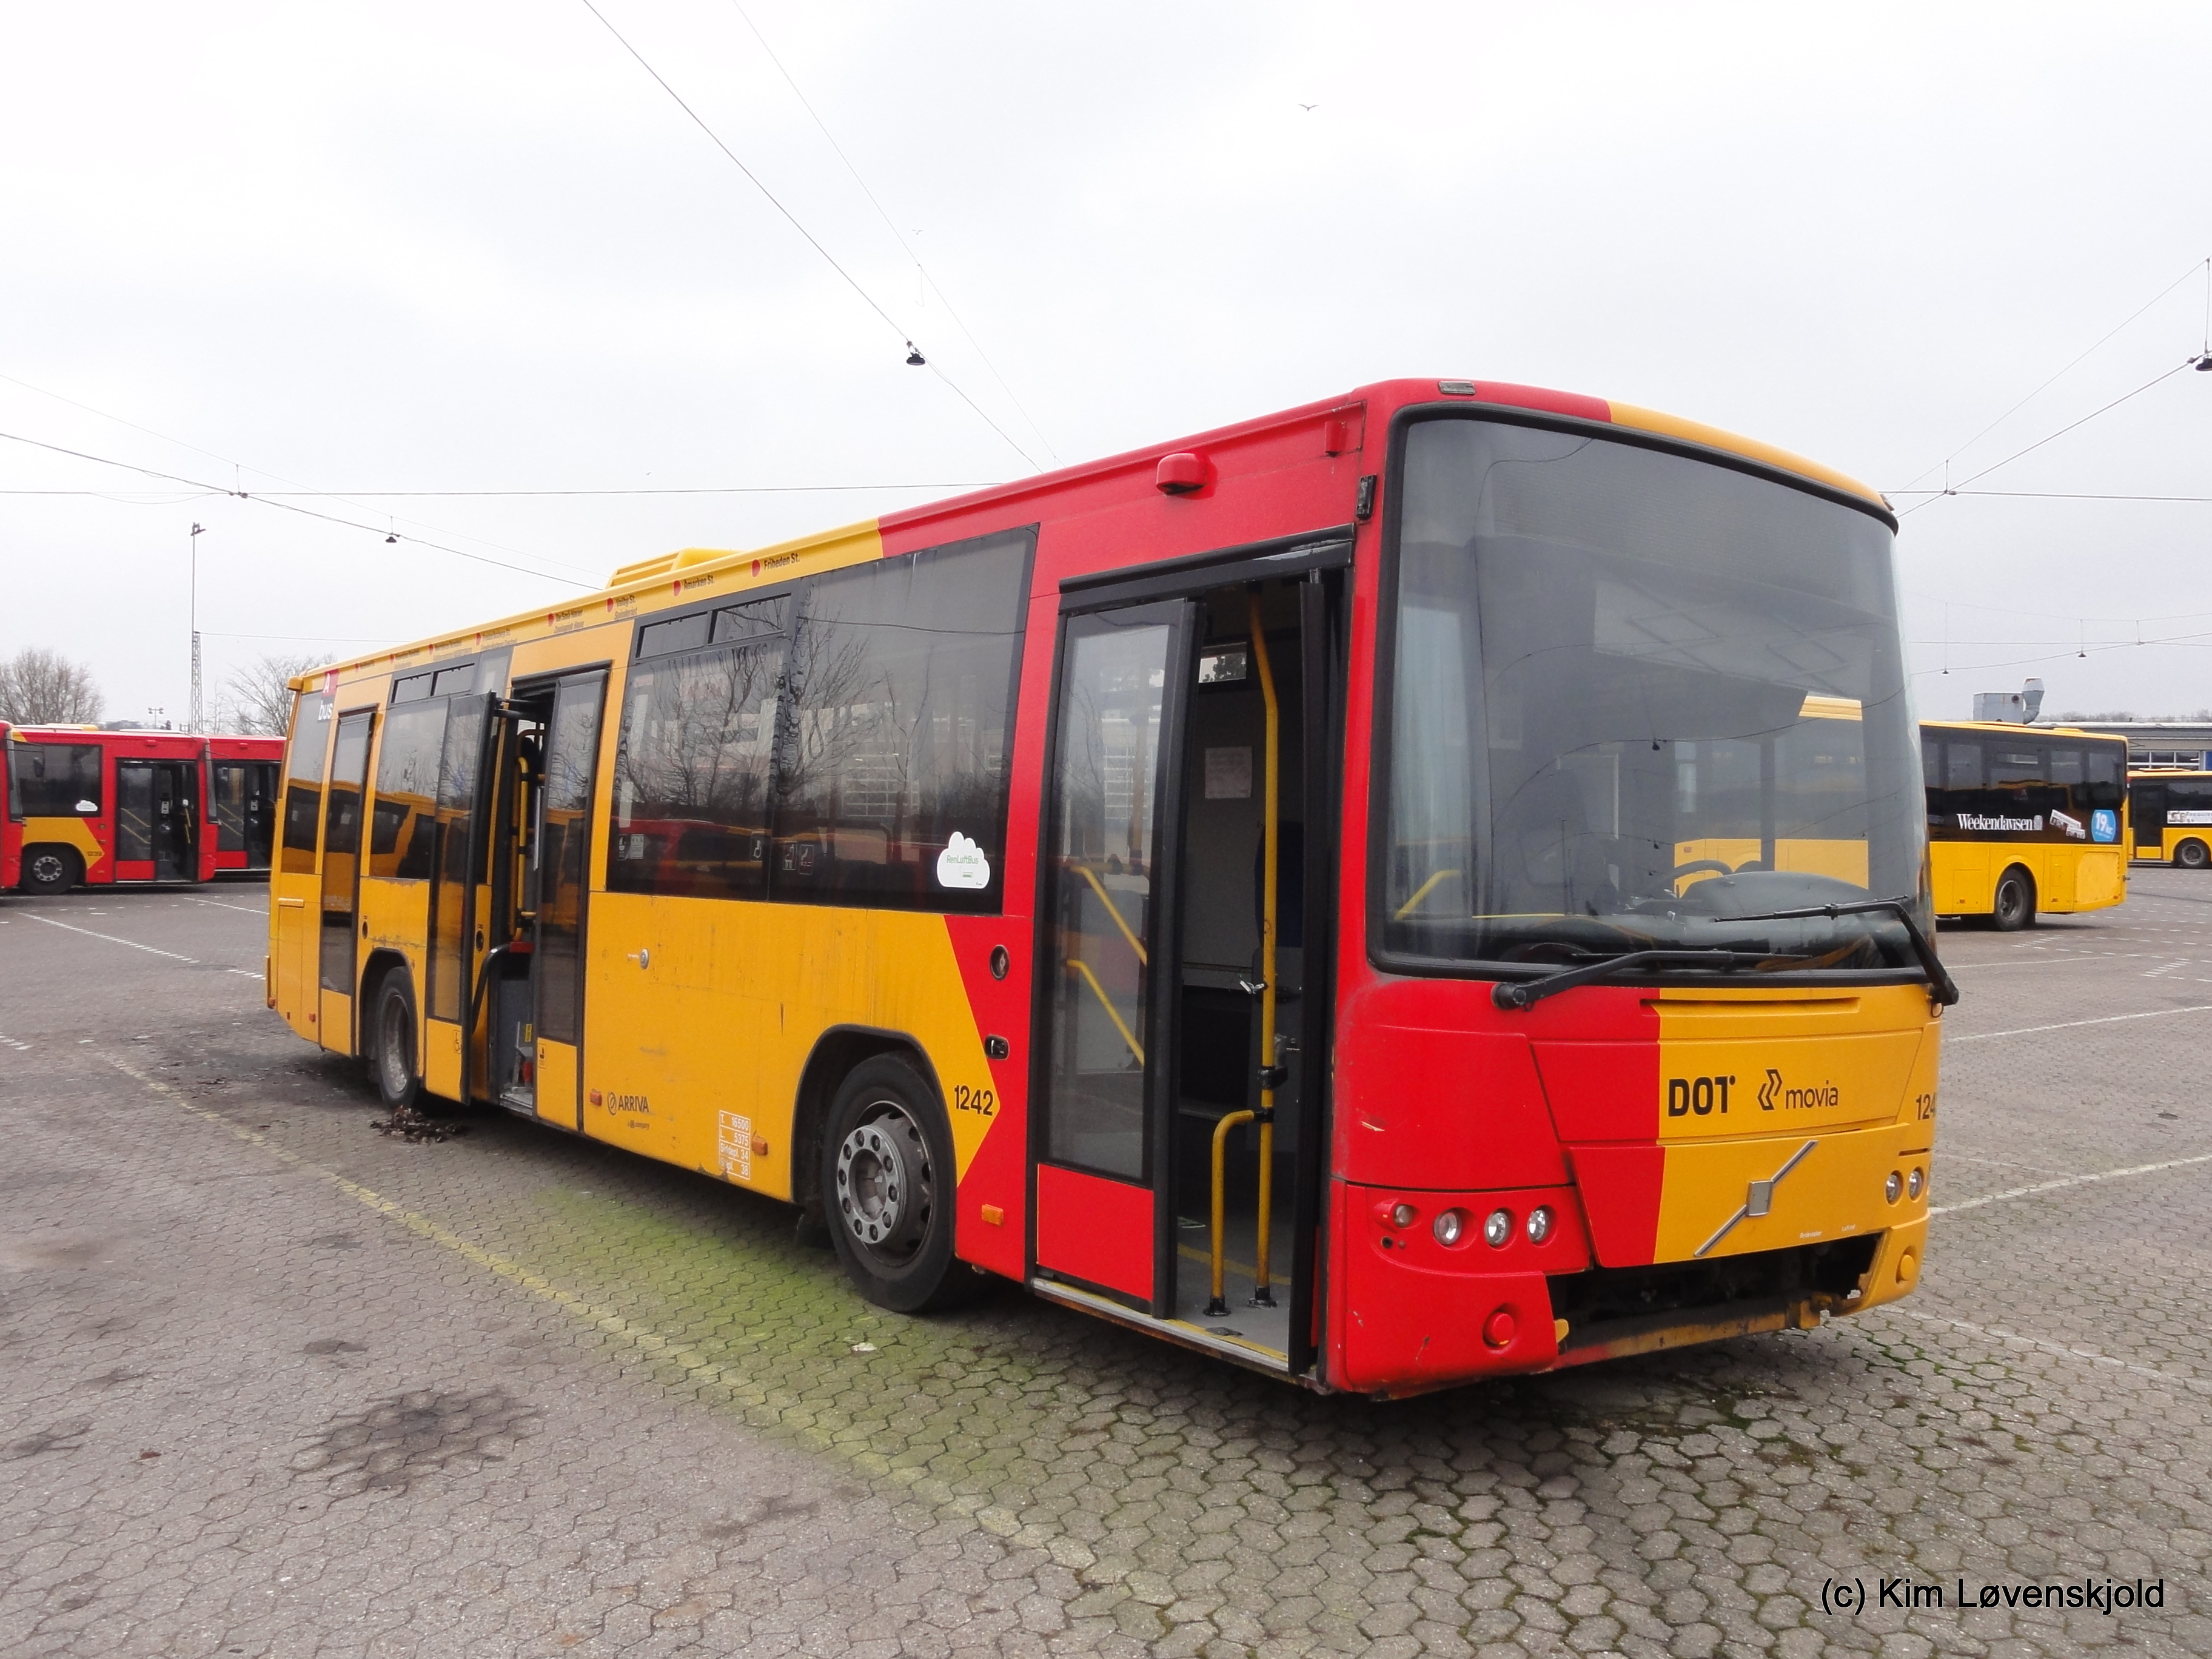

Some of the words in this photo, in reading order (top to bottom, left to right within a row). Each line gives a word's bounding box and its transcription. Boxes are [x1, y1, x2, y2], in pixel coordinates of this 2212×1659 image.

[764, 555, 790, 571] Friheden
[791, 552, 800, 564] St.
[323, 673, 330, 693] A
[318, 700, 333, 720] bus
[1956, 813, 2033, 831] Weekendavisen
[2096, 812, 2108, 831] 19
[947, 855, 979, 864] RenLuftBus
[618, 1095, 649, 1113] ARRIVA
[954, 1085, 993, 1116] 1242
[1668, 1075, 1735, 1117] DOT
[1786, 1080, 1838, 1109] movia
[731, 1116, 749, 1131] 16500
[734, 1132, 748, 1146] 5375
[741, 1149, 748, 1161] 34
